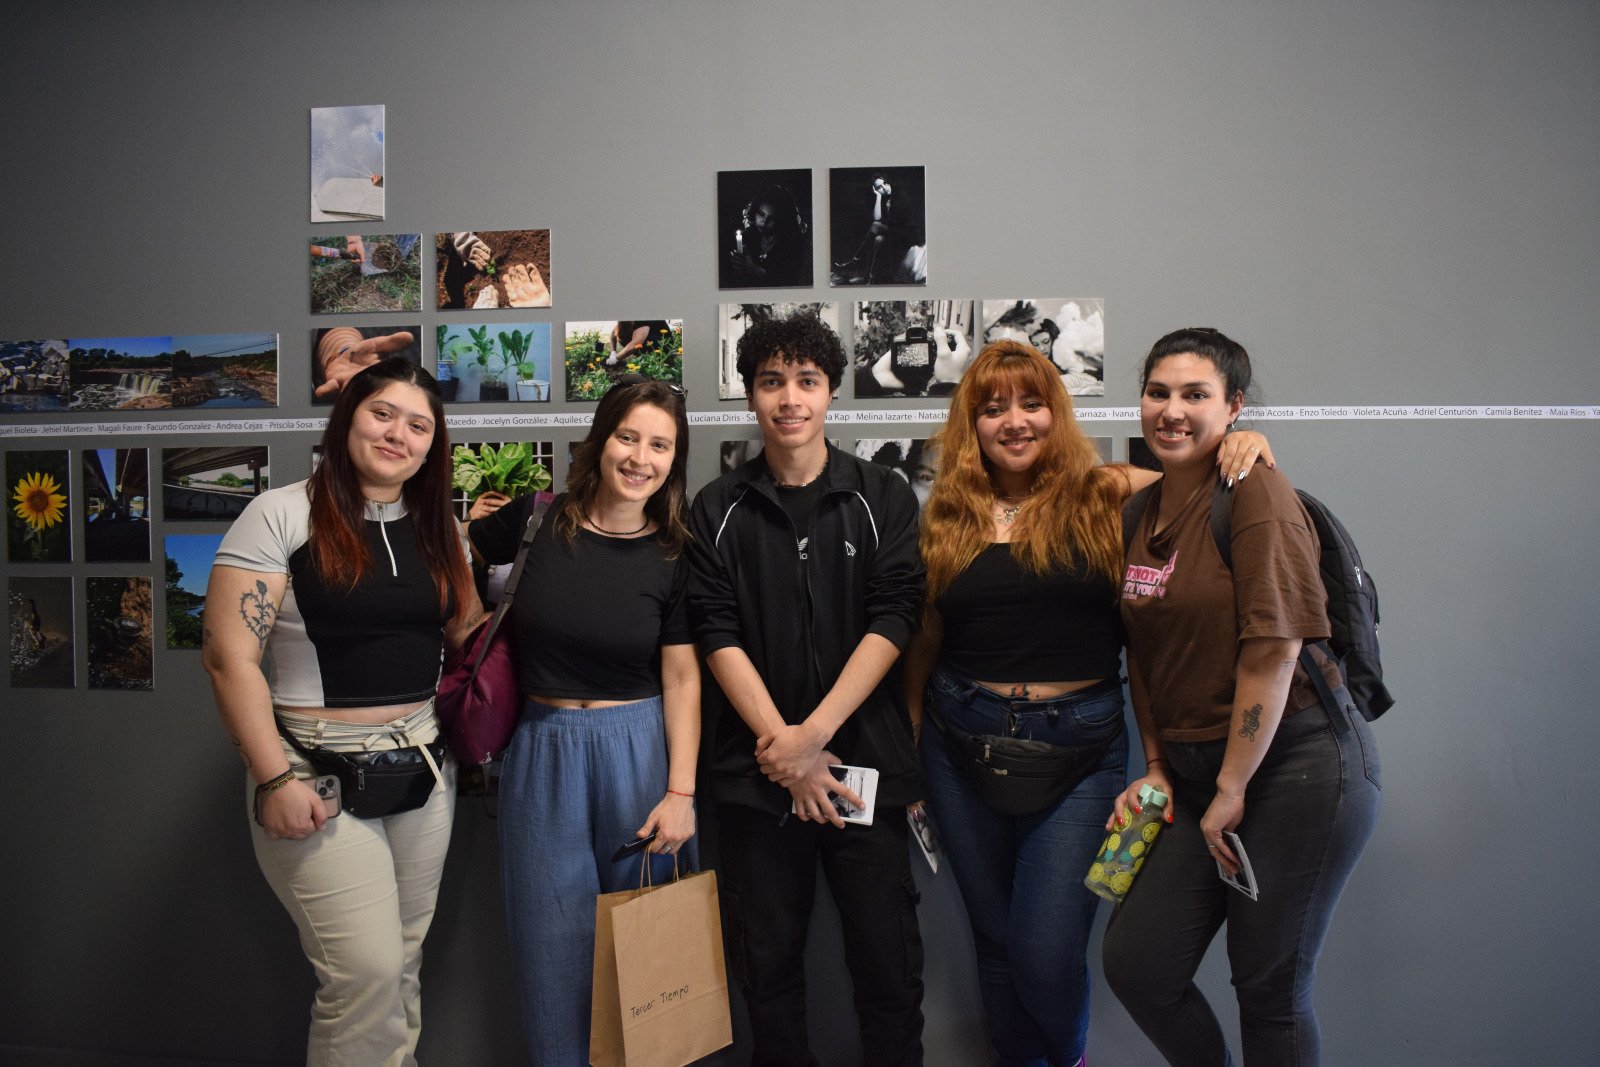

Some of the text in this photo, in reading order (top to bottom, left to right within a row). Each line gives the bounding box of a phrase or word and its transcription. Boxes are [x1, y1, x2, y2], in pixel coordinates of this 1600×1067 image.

[147, 423, 177, 431] Facundo
[216, 422, 243, 430] Andrea
[244, 421, 263, 431] Cejas
[296, 420, 313, 429] Sosa
[482, 416, 511, 427] Jocelyn
[512, 416, 548, 425] González
[553, 415, 582, 426] Aquiles
[690, 414, 721, 422] Luciana
[722, 413, 741, 422] Diris
[834, 412, 851, 422] Kap
[856, 412, 883, 420] Melina
[1112, 410, 1134, 418] Ivana
[1267, 408, 1294, 417] Acosta
[1299, 408, 1320, 416] Enzo
[1320, 408, 1348, 416] Toledo
[1352, 408, 1381, 416] Violeta
[1413, 408, 1437, 416] Adriel
[1438, 407, 1478, 416] Centurión
[1485, 407, 1512, 416] Camila
[1549, 408, 1569, 416] Maia
[630, 985, 689, 1019] Tercer Tiempo
